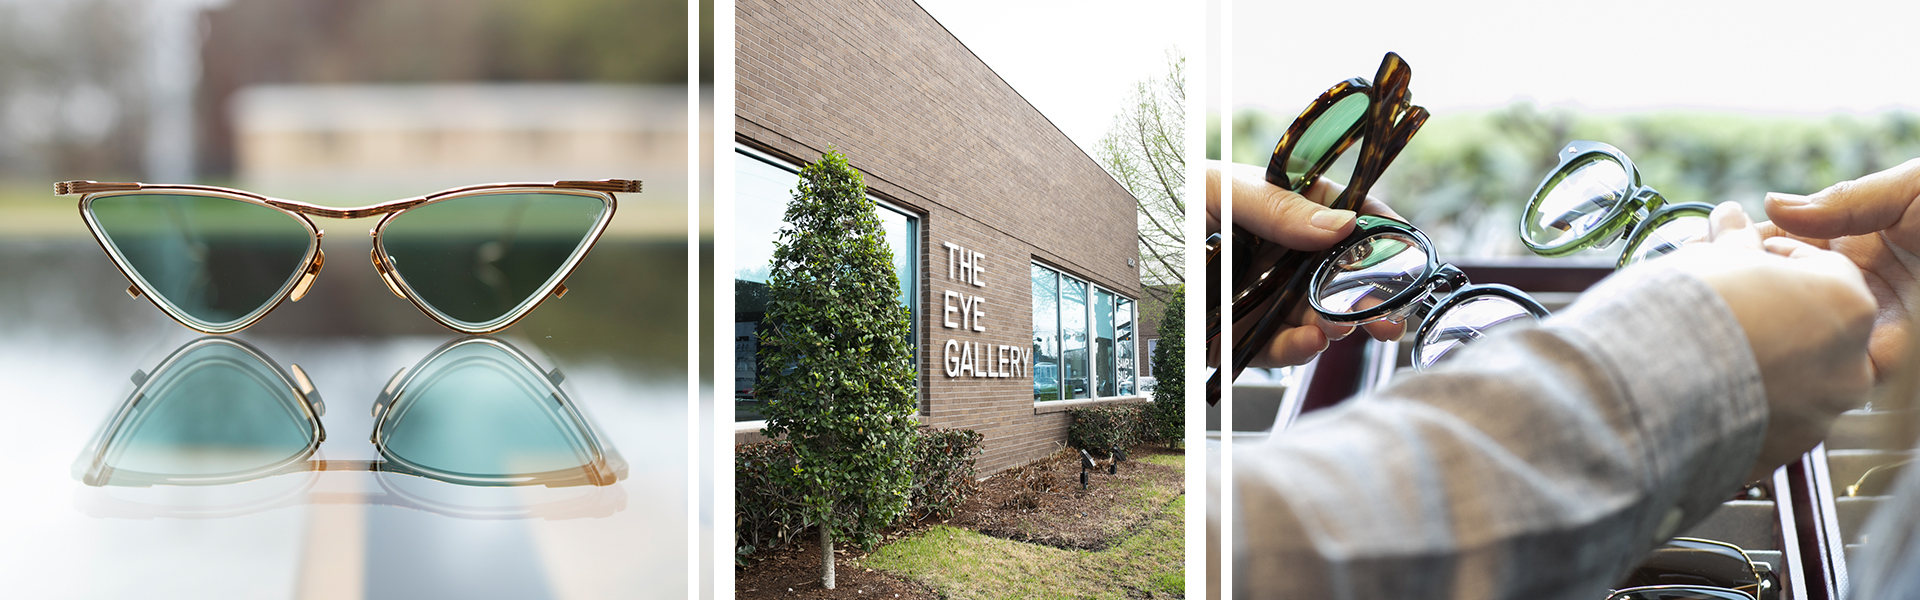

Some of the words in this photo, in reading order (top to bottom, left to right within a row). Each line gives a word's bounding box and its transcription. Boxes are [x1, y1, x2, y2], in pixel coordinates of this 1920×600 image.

[944, 240, 986, 287] THE
[944, 289, 986, 332] EYE
[944, 338, 1030, 378] GALLERY
